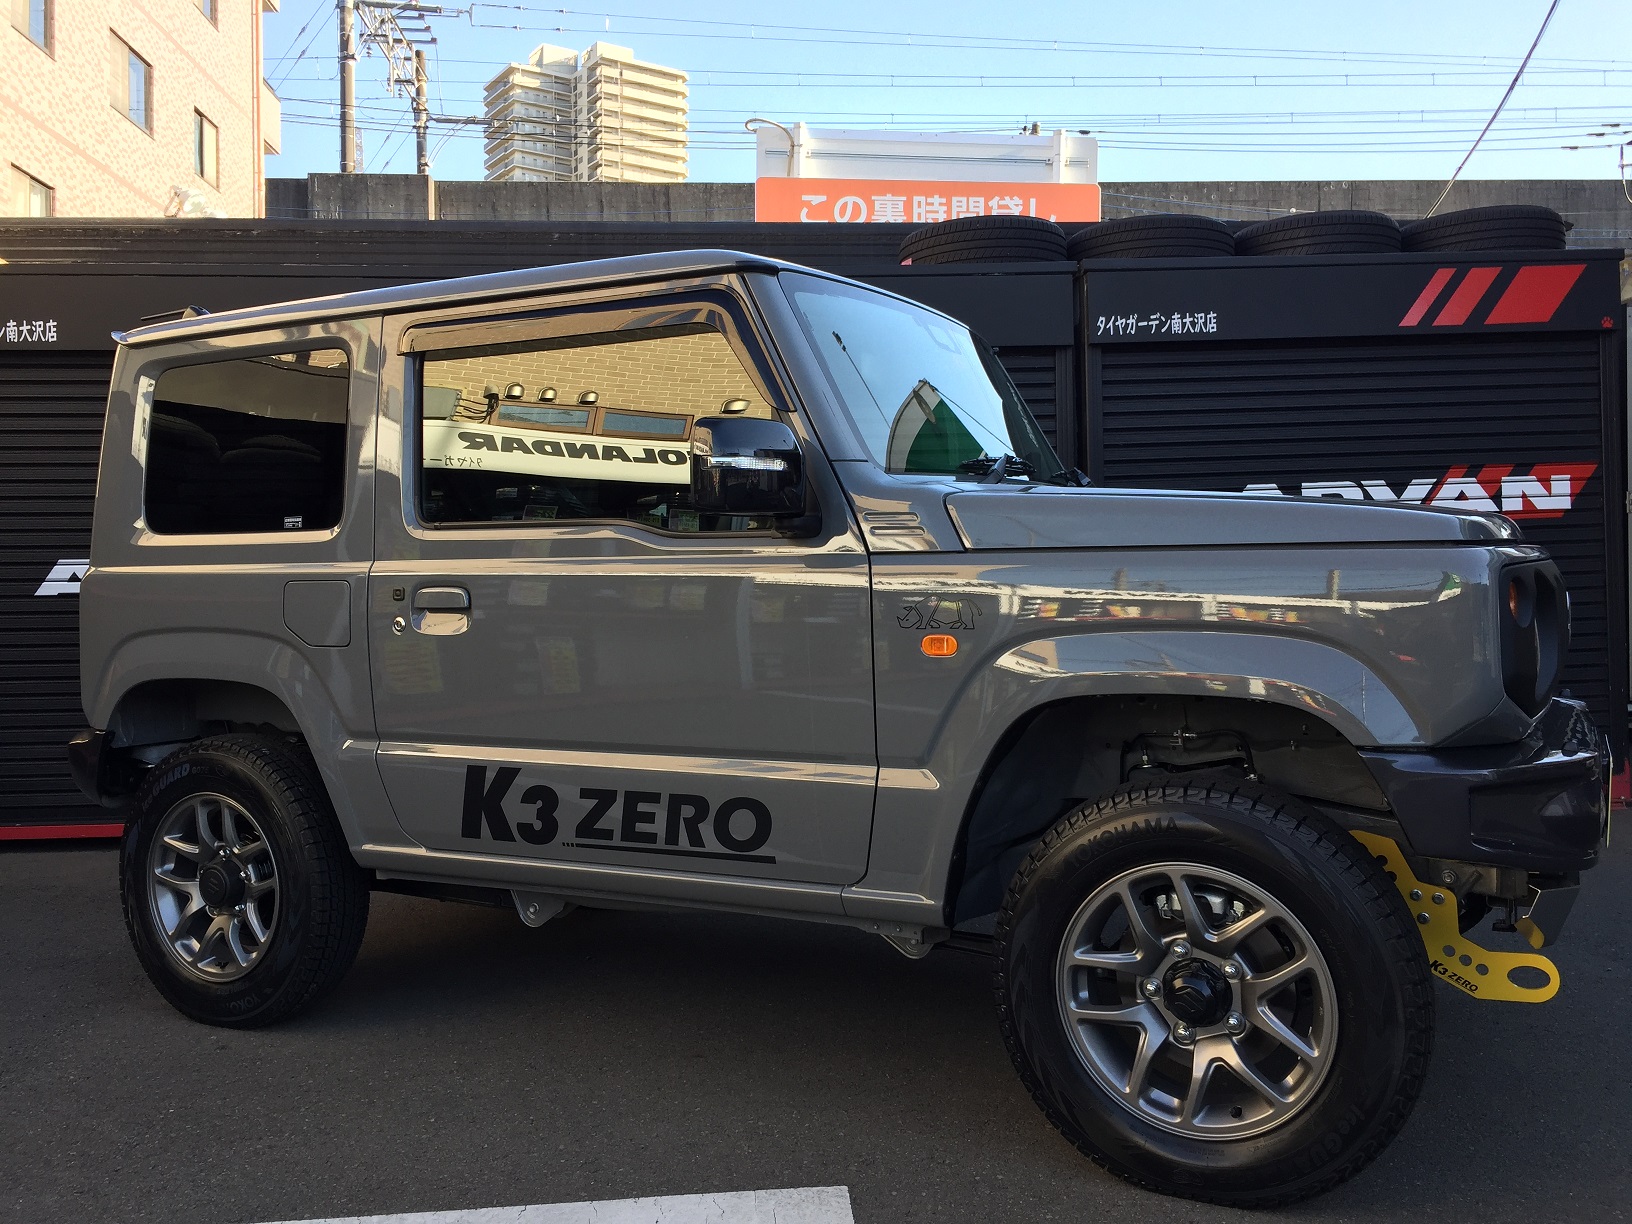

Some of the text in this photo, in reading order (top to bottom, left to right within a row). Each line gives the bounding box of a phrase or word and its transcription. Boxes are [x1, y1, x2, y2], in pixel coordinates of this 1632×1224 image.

[1097, 311, 1217, 336] タイヤガーデン南大沢店
[461, 765, 772, 853] K3 ZERO
[1430, 959, 1479, 993] K3 ZERO
